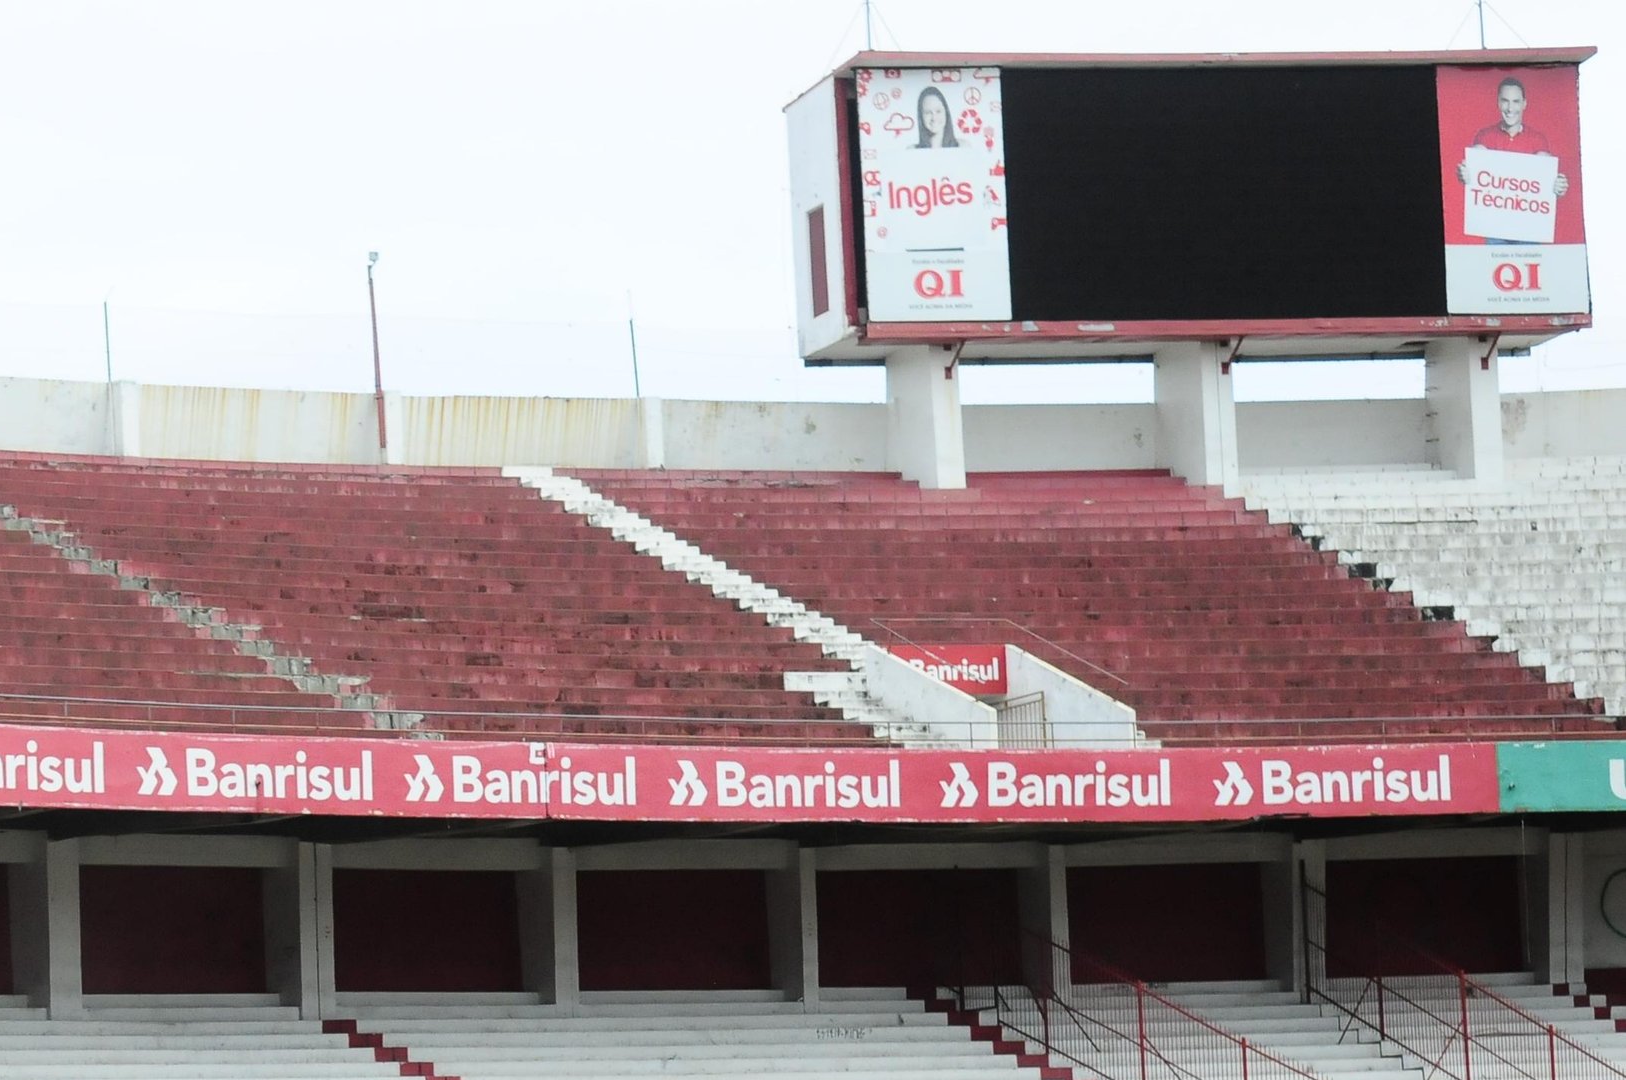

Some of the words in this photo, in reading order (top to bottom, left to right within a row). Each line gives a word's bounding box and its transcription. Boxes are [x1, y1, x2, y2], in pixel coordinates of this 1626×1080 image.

[888, 176, 974, 216] Inglês
[1471, 189, 1551, 214] Técnicos
[1476, 170, 1541, 194] Cursos
[914, 269, 965, 299] QI
[1492, 263, 1542, 292] QI
[186, 748, 374, 801] Banrisul
[452, 755, 637, 806] Banrisul
[716, 760, 901, 809] Banrisul
[987, 759, 1171, 808] Banrisul
[1261, 755, 1452, 805] Banrisul
